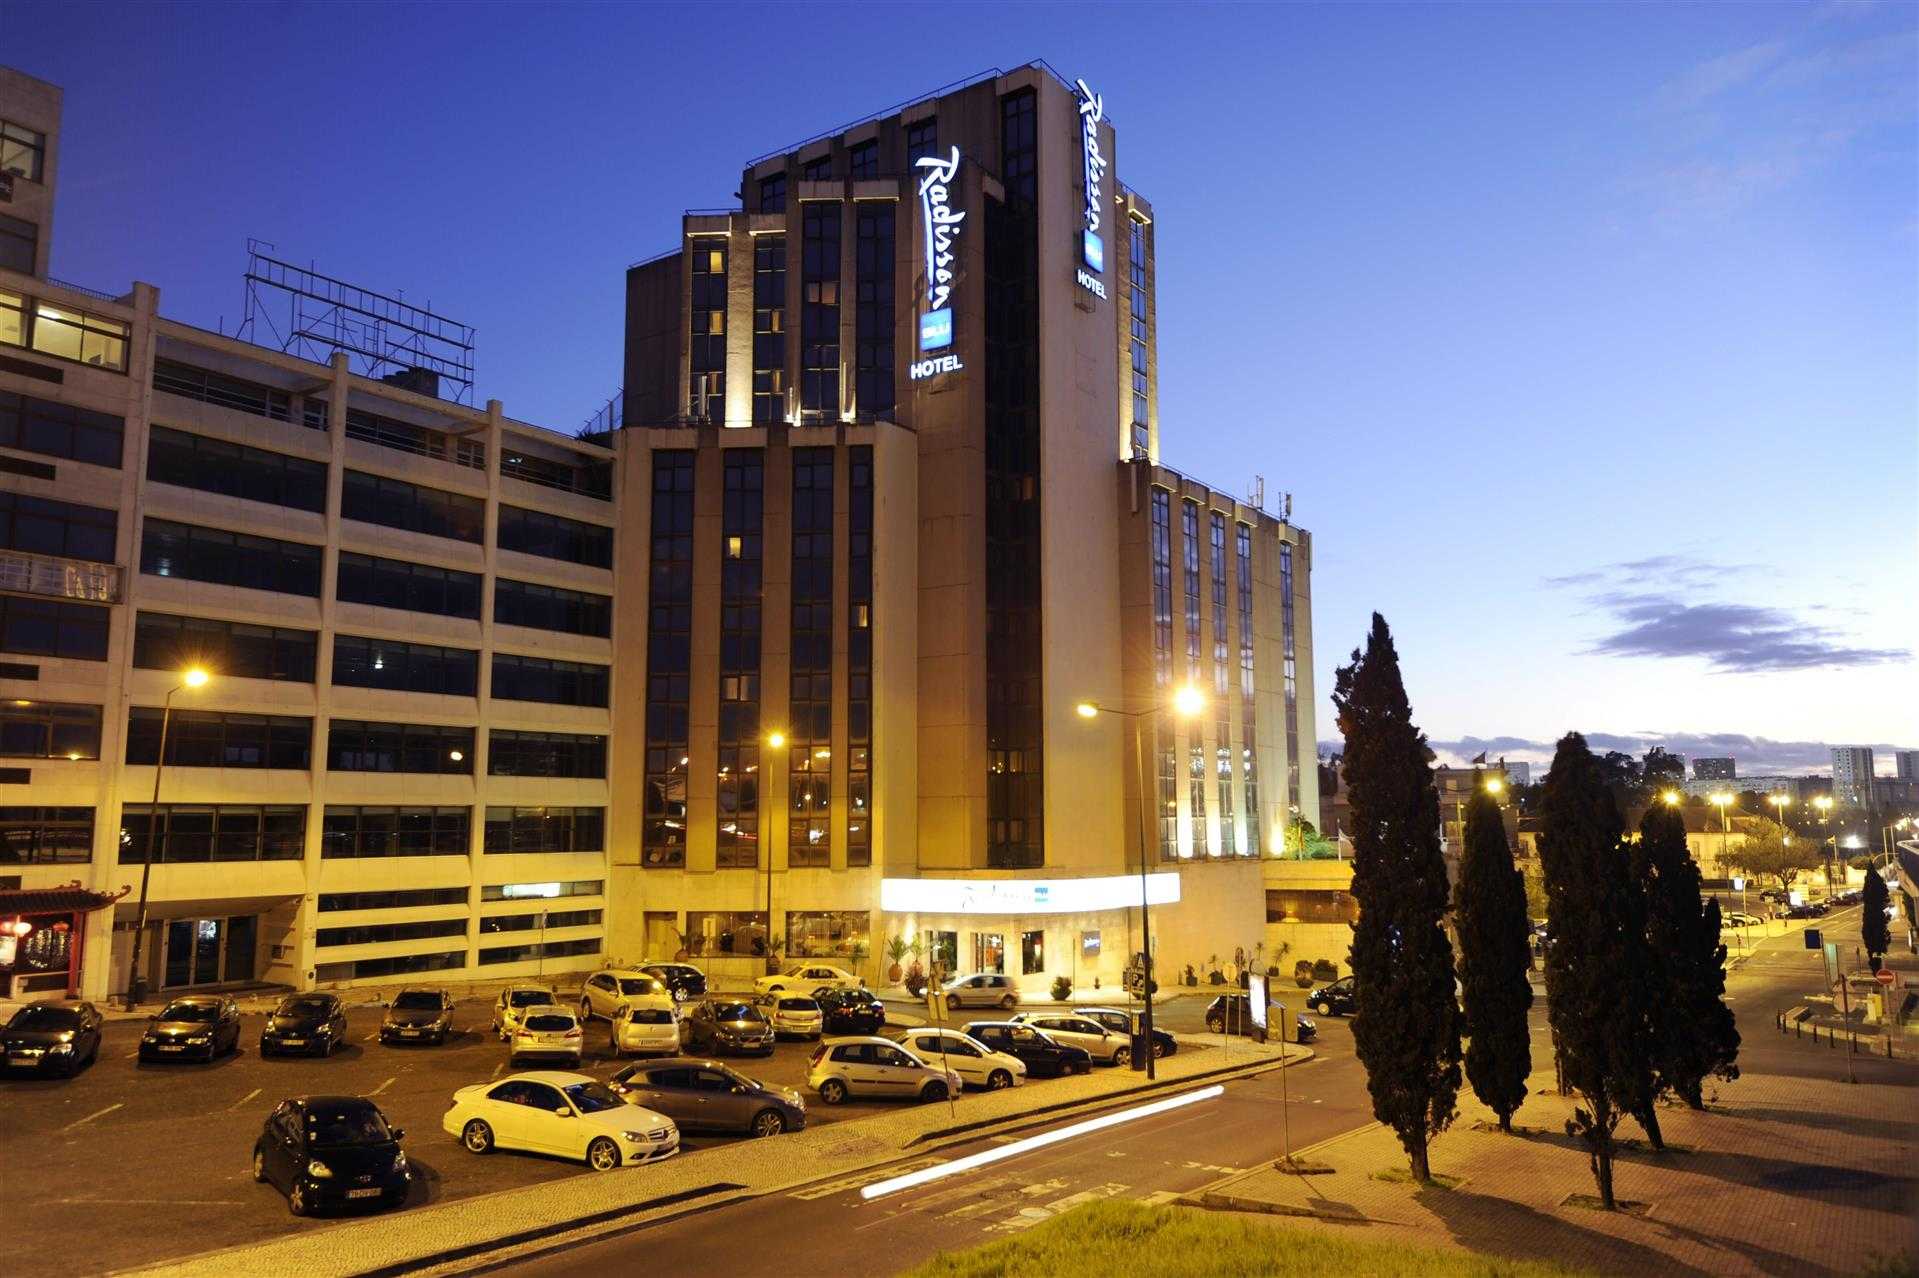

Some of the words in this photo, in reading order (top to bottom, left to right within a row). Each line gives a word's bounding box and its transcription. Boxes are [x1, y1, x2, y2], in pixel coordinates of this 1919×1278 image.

[1076, 78, 1107, 231] Radisson
[916, 145, 966, 310] Radisson
[1077, 268, 1107, 300] HOTEL
[910, 354, 963, 380] HOTEL
